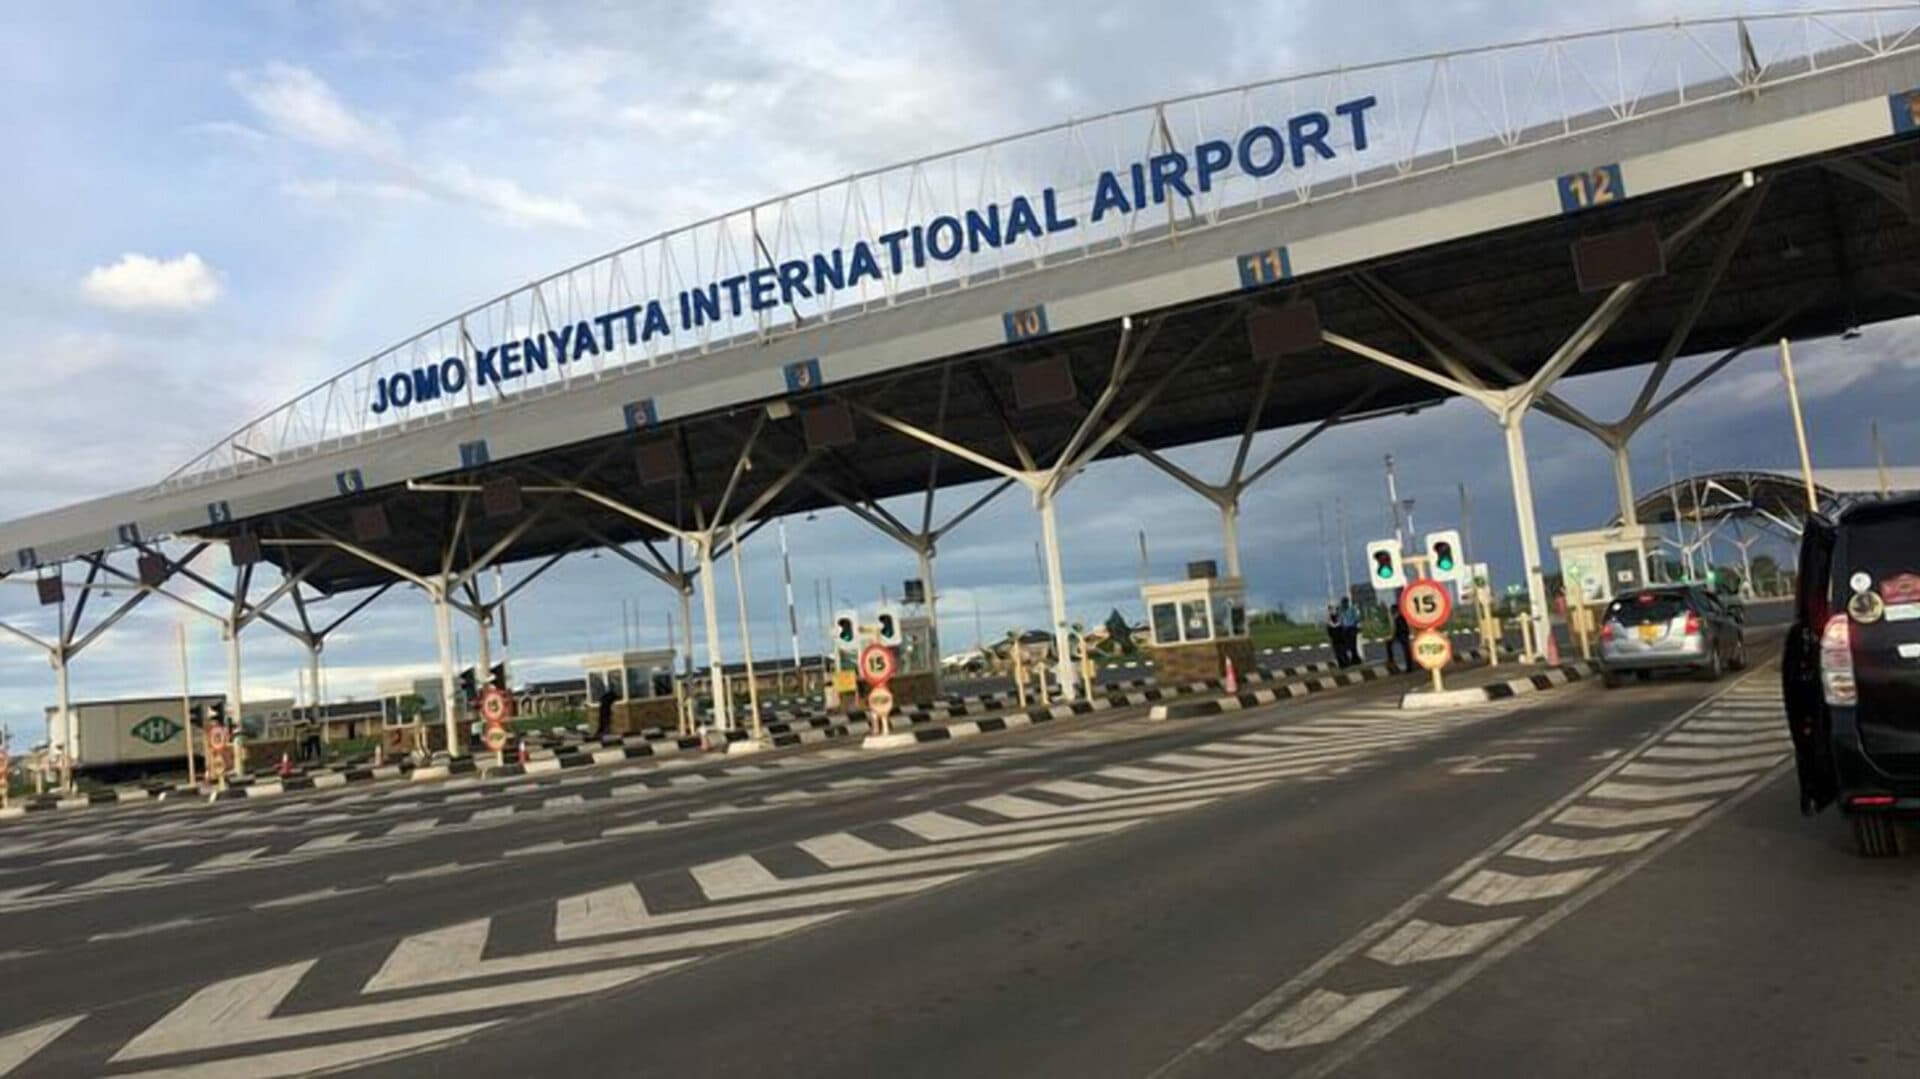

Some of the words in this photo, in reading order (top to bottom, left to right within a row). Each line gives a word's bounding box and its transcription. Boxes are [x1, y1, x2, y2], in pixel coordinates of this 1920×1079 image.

[1569, 168, 1614, 208] 12
[372, 357, 466, 413] JOMO
[475, 304, 670, 386] KENYATTA
[679, 188, 1076, 331] INTERNATIONAL
[1091, 96, 1377, 222] AIRPORT
[1247, 249, 1282, 284] 11
[1012, 309, 1040, 337] 10
[1412, 594, 1437, 614] 15
[1418, 642, 1446, 656] STOP
[868, 656, 886, 671] 15
